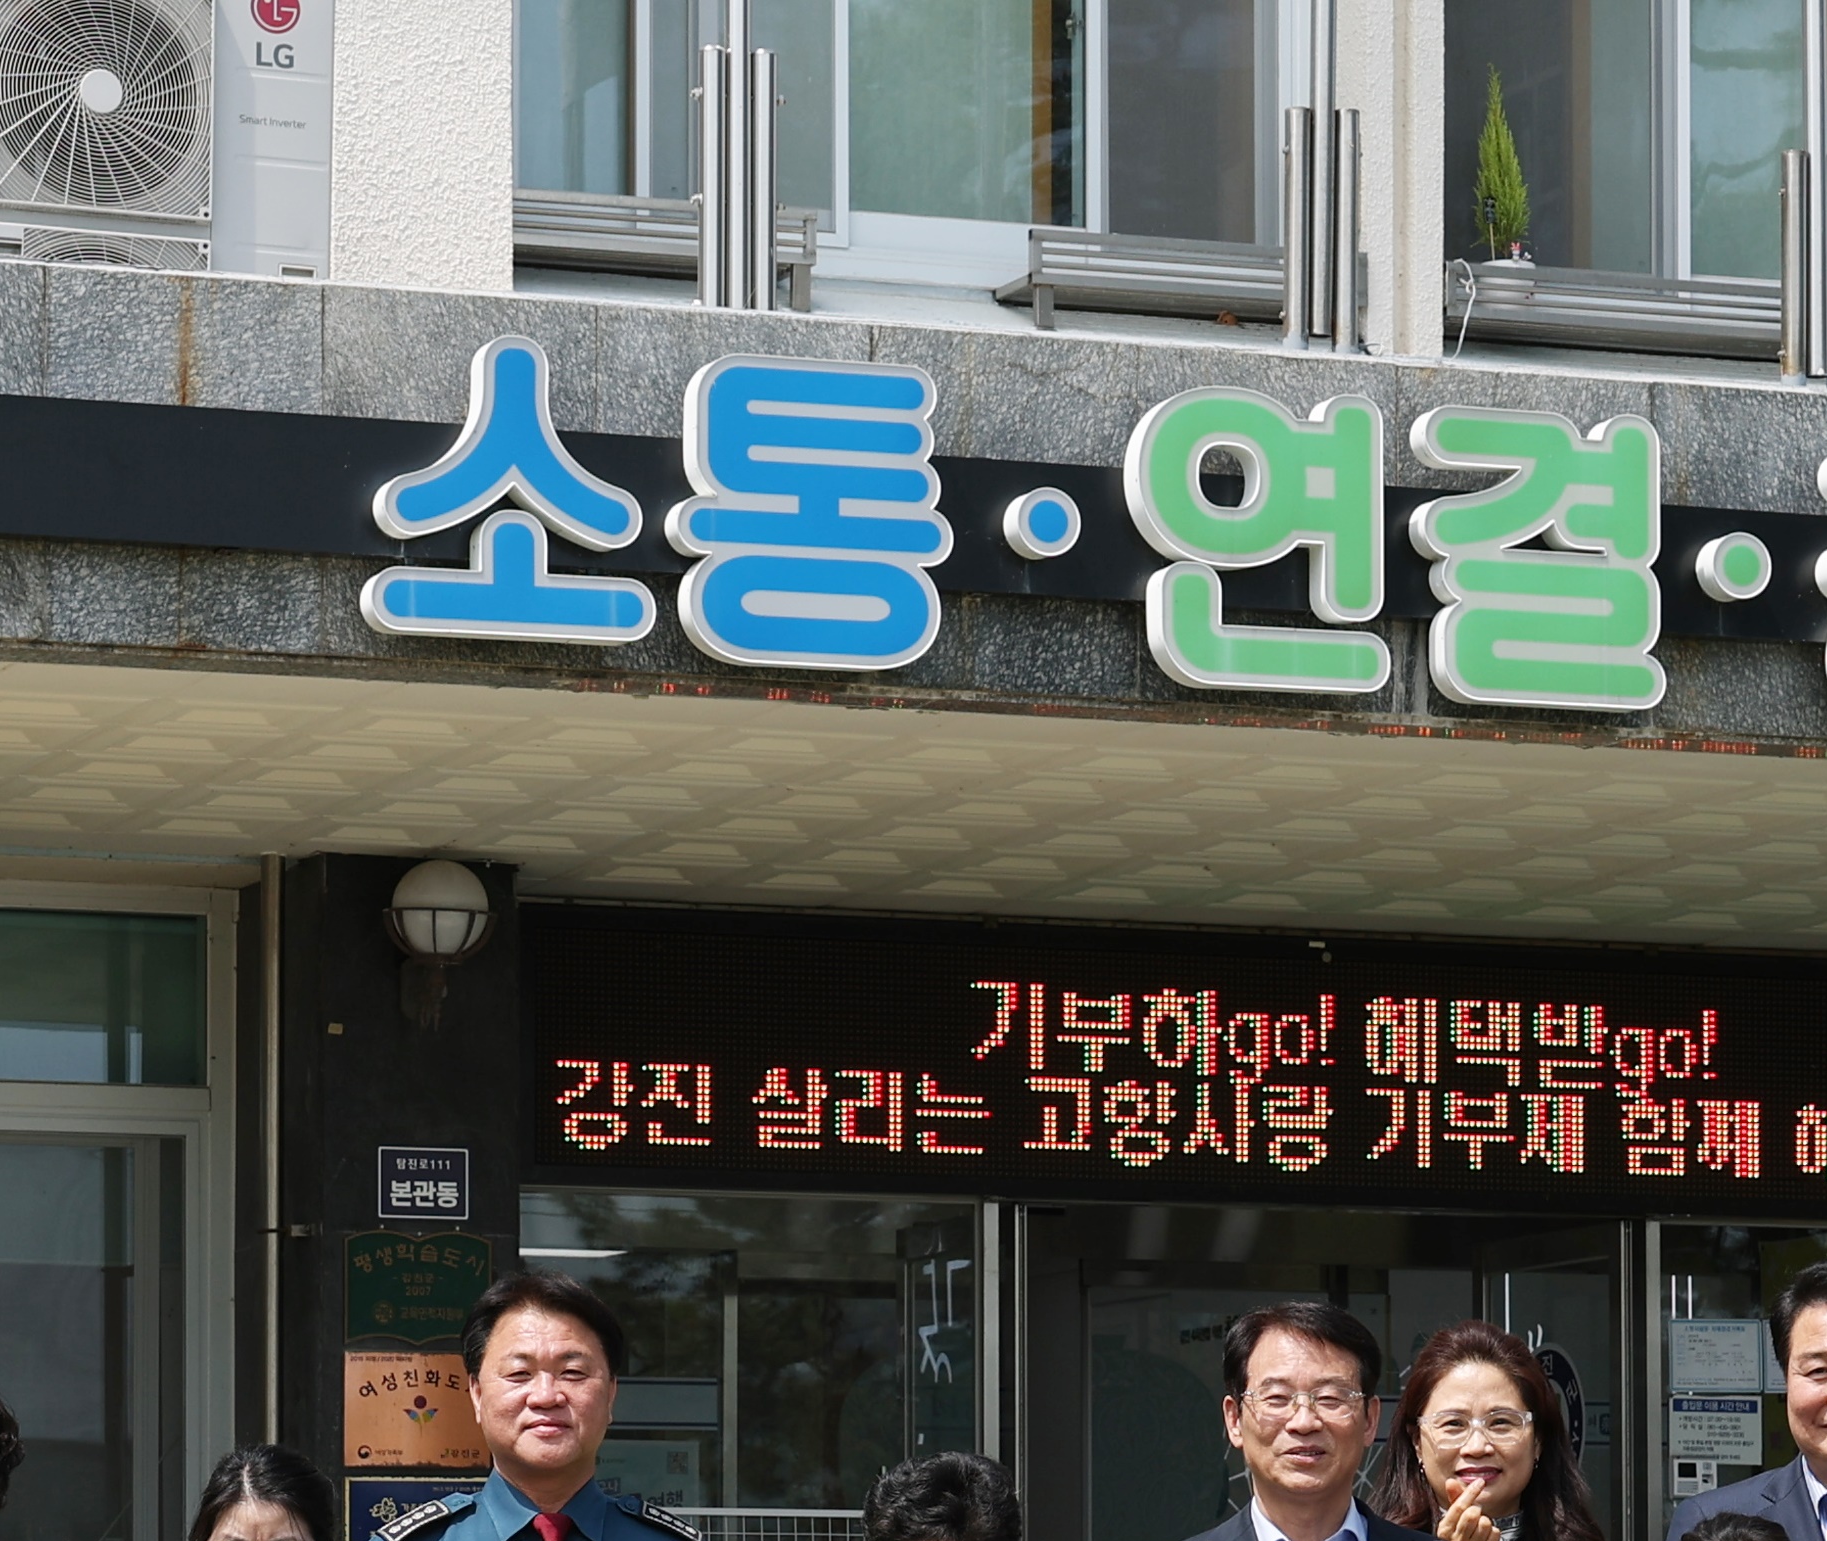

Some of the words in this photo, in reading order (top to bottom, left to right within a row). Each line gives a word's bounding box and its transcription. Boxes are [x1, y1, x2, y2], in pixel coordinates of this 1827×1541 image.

[256, 41, 295, 69] LG
[239, 113, 268, 126] Smart
[269, 116, 307, 129] Inverter
[971, 979, 1336, 1083] 기부하go!
[556, 1059, 712, 1151] 강진
[751, 1066, 992, 1155] 살리는
[1024, 1077, 1335, 1173] 고향사랑
[1366, 1088, 1585, 1173] 기부제
[1618, 1098, 1761, 1178] 함께
[396, 1158, 451, 1170] 탐진로111
[390, 1180, 459, 1208] 본관동
[353, 1243, 486, 1276] 평생학습도시
[405, 1286, 432, 1296] 2007
[359, 1369, 471, 1398] 여성친화도
